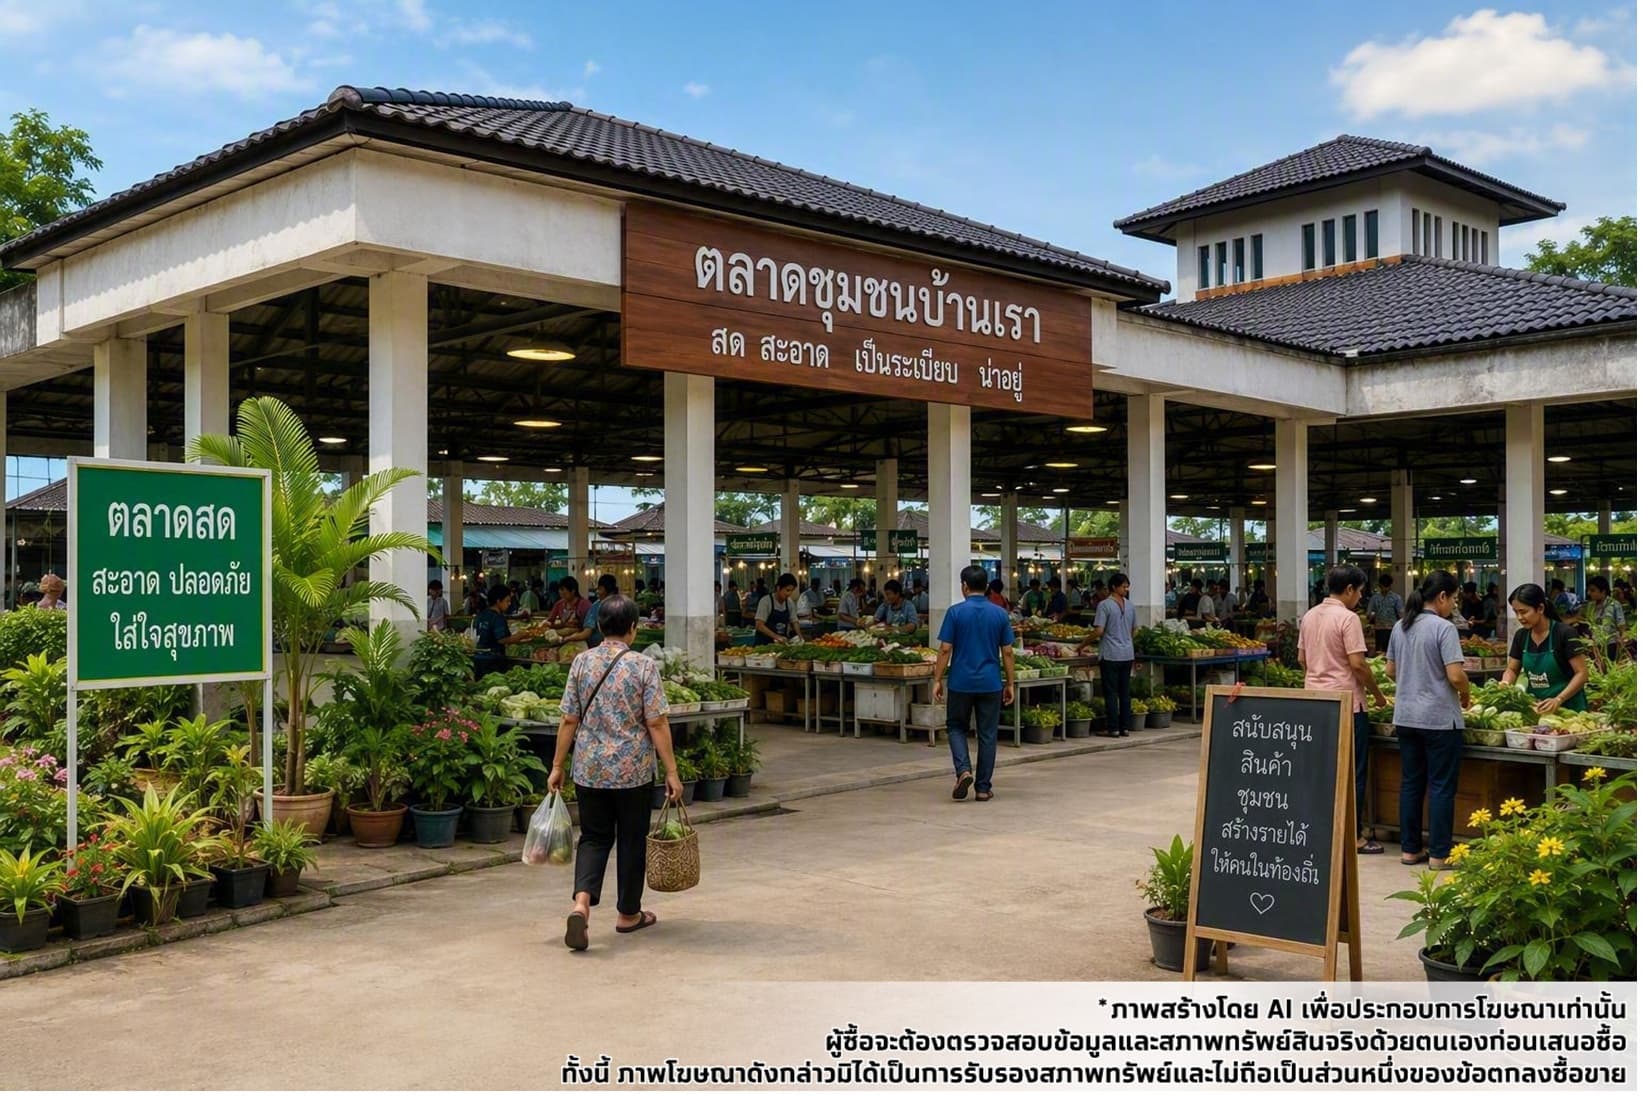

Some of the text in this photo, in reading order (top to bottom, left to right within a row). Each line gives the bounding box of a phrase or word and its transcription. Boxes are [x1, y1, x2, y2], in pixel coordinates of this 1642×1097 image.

[694, 245, 1041, 344] ตลาดชุมชนบ้านเรา
[711, 327, 1023, 402] สด สะอาด เป็นระเบียบ น่าอยู่
[108, 501, 236, 540] ตลาดสด
[92, 560, 251, 595] สะอาด ปลอดภัย
[110, 611, 234, 661] ใส่ใจสุขภาพ
[1232, 713, 1313, 750] สนับสนุน
[1240, 749, 1292, 777] สินค้า
[1237, 788, 1289, 814] ชุมชน
[1221, 817, 1310, 846] สร้างรายได้
